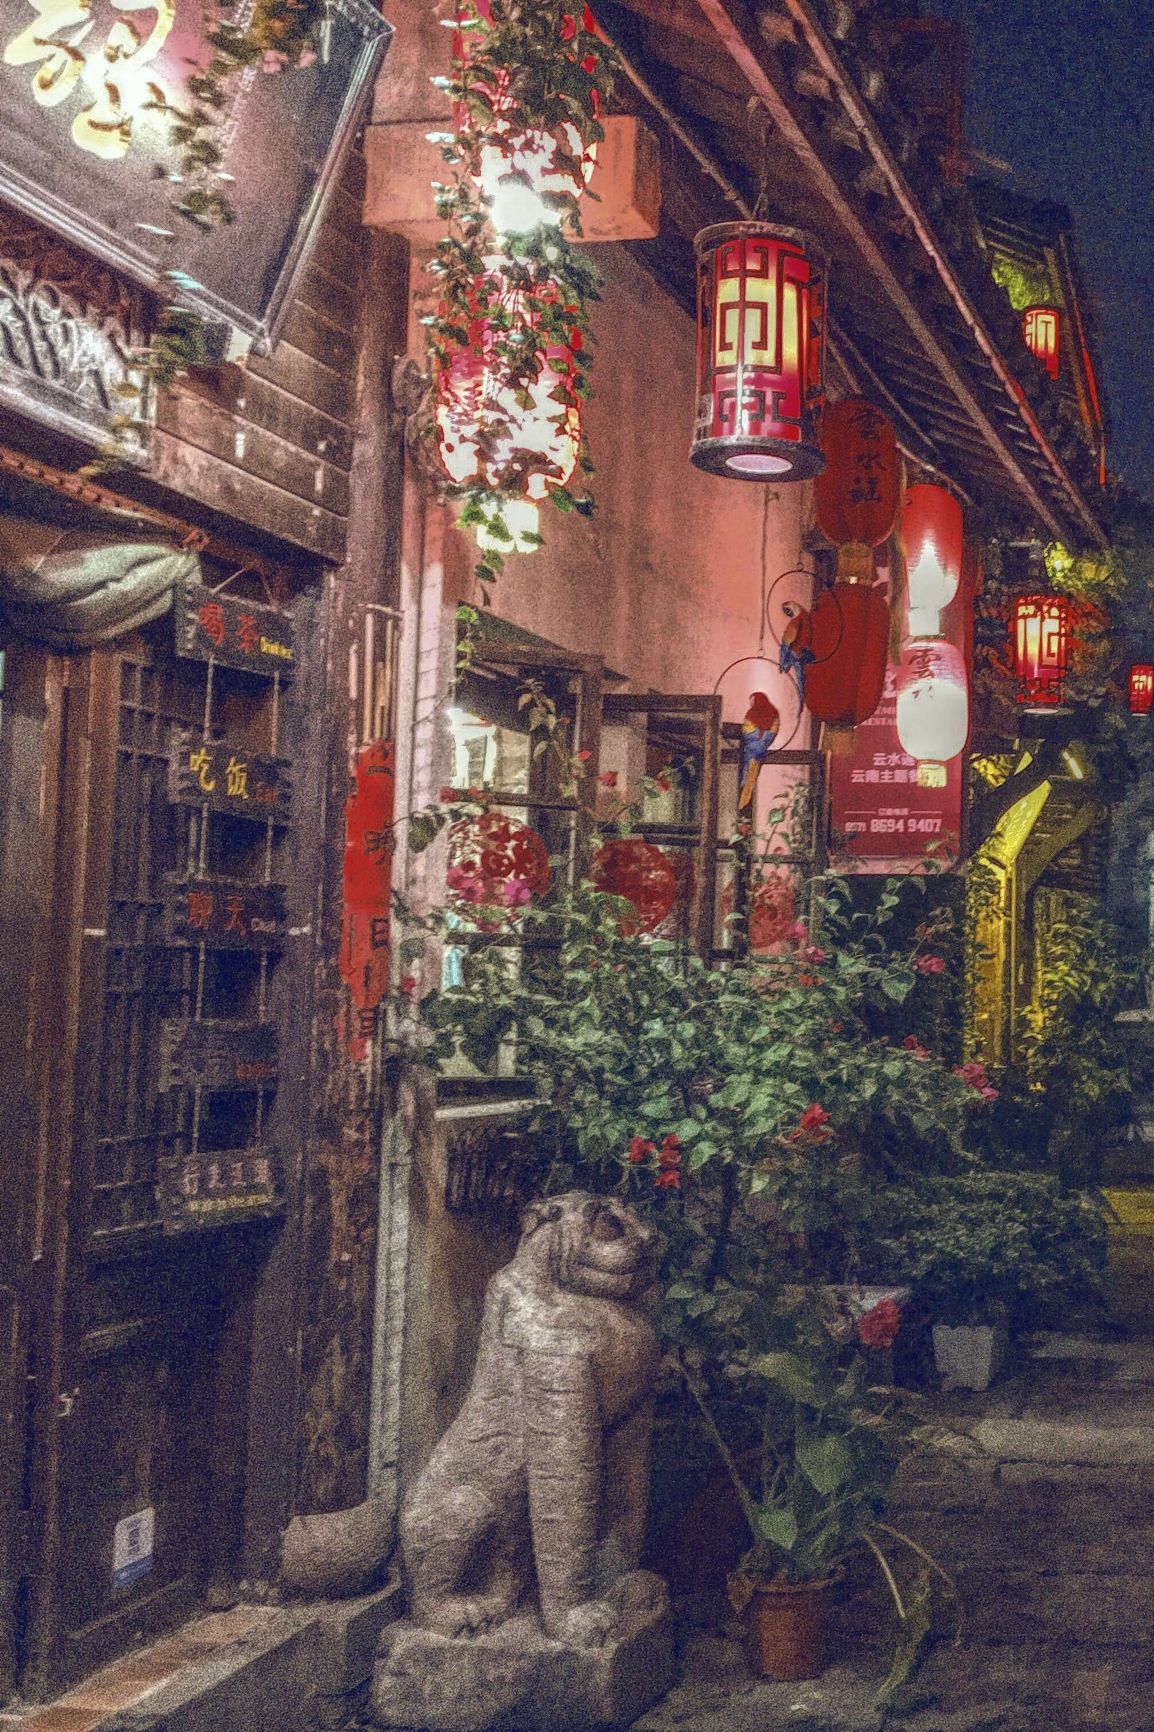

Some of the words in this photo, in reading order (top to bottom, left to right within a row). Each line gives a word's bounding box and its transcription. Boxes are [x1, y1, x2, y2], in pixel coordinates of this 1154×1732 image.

[198, 601, 259, 653] 喝茶
[190, 747, 249, 799] 吃饭
[870, 818, 904, 833] 8694
[907, 818, 942, 833] 9407
